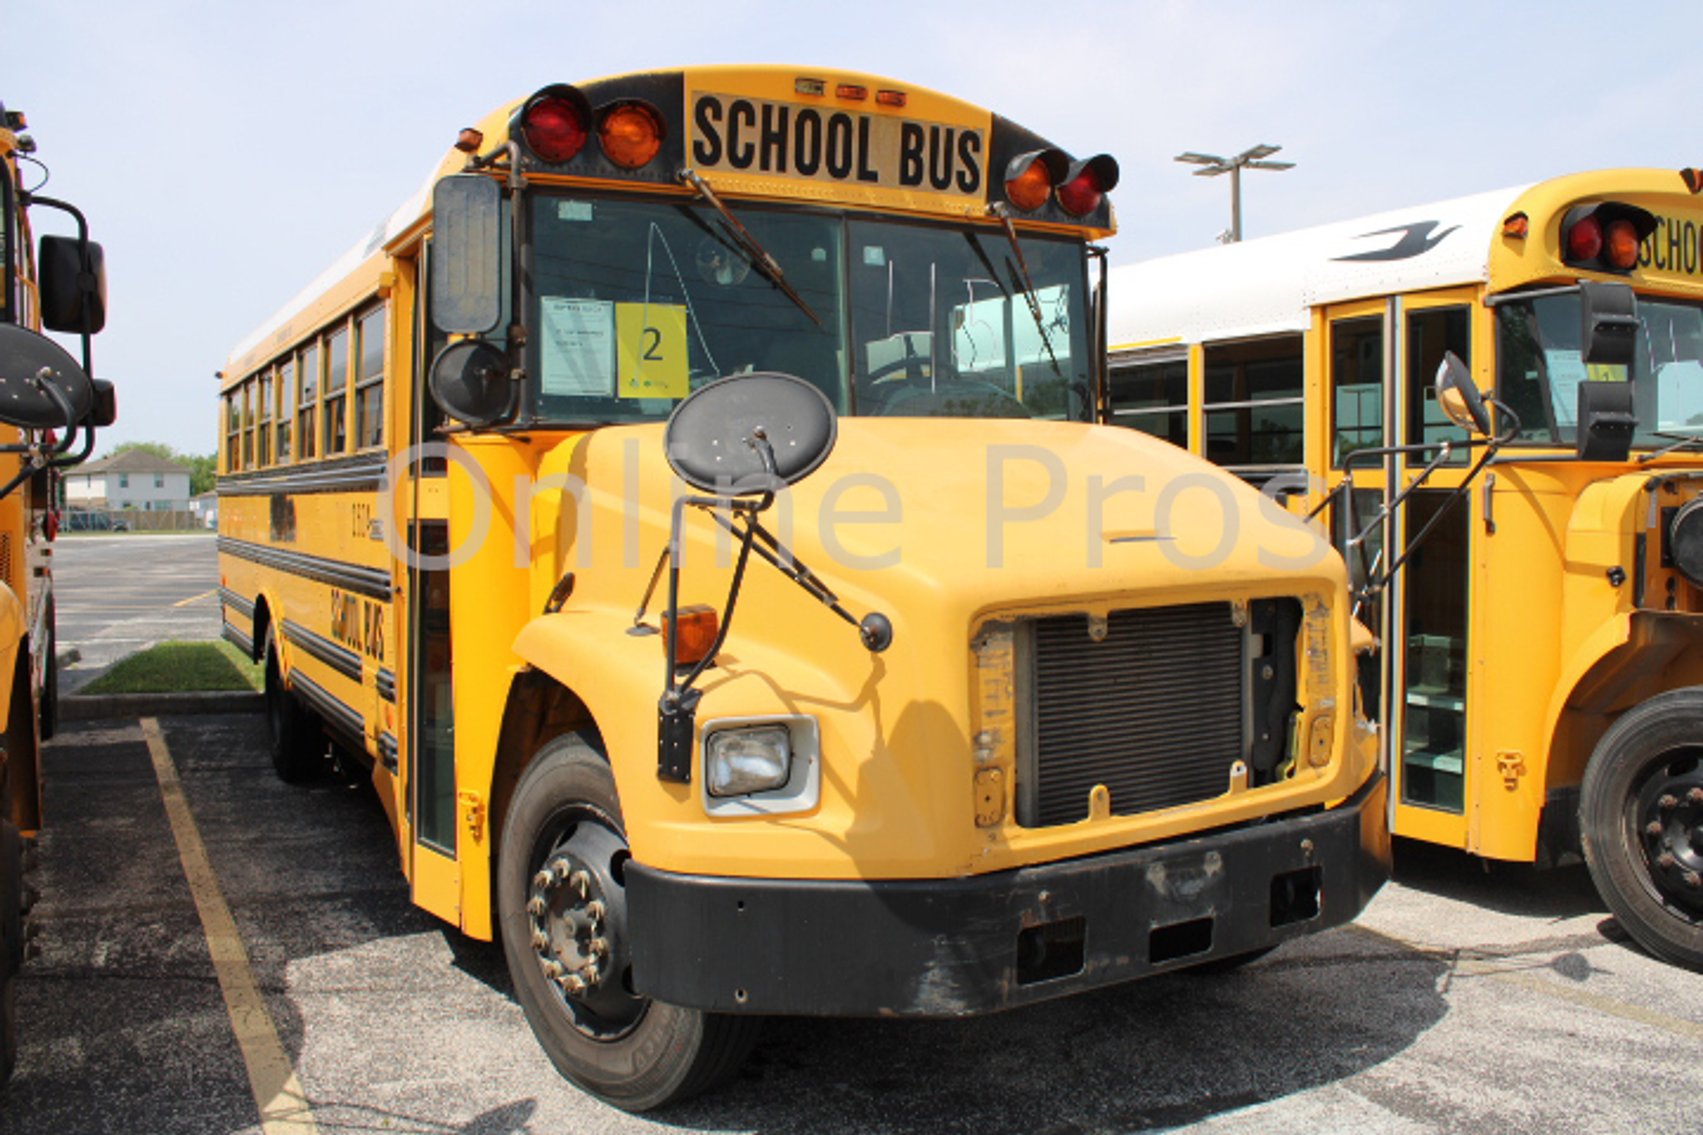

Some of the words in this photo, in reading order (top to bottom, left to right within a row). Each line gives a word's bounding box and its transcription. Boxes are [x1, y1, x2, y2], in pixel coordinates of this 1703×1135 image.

[693, 96, 878, 182] SCHOOL
[899, 122, 981, 193] BUS
[642, 326, 663, 361] 2
